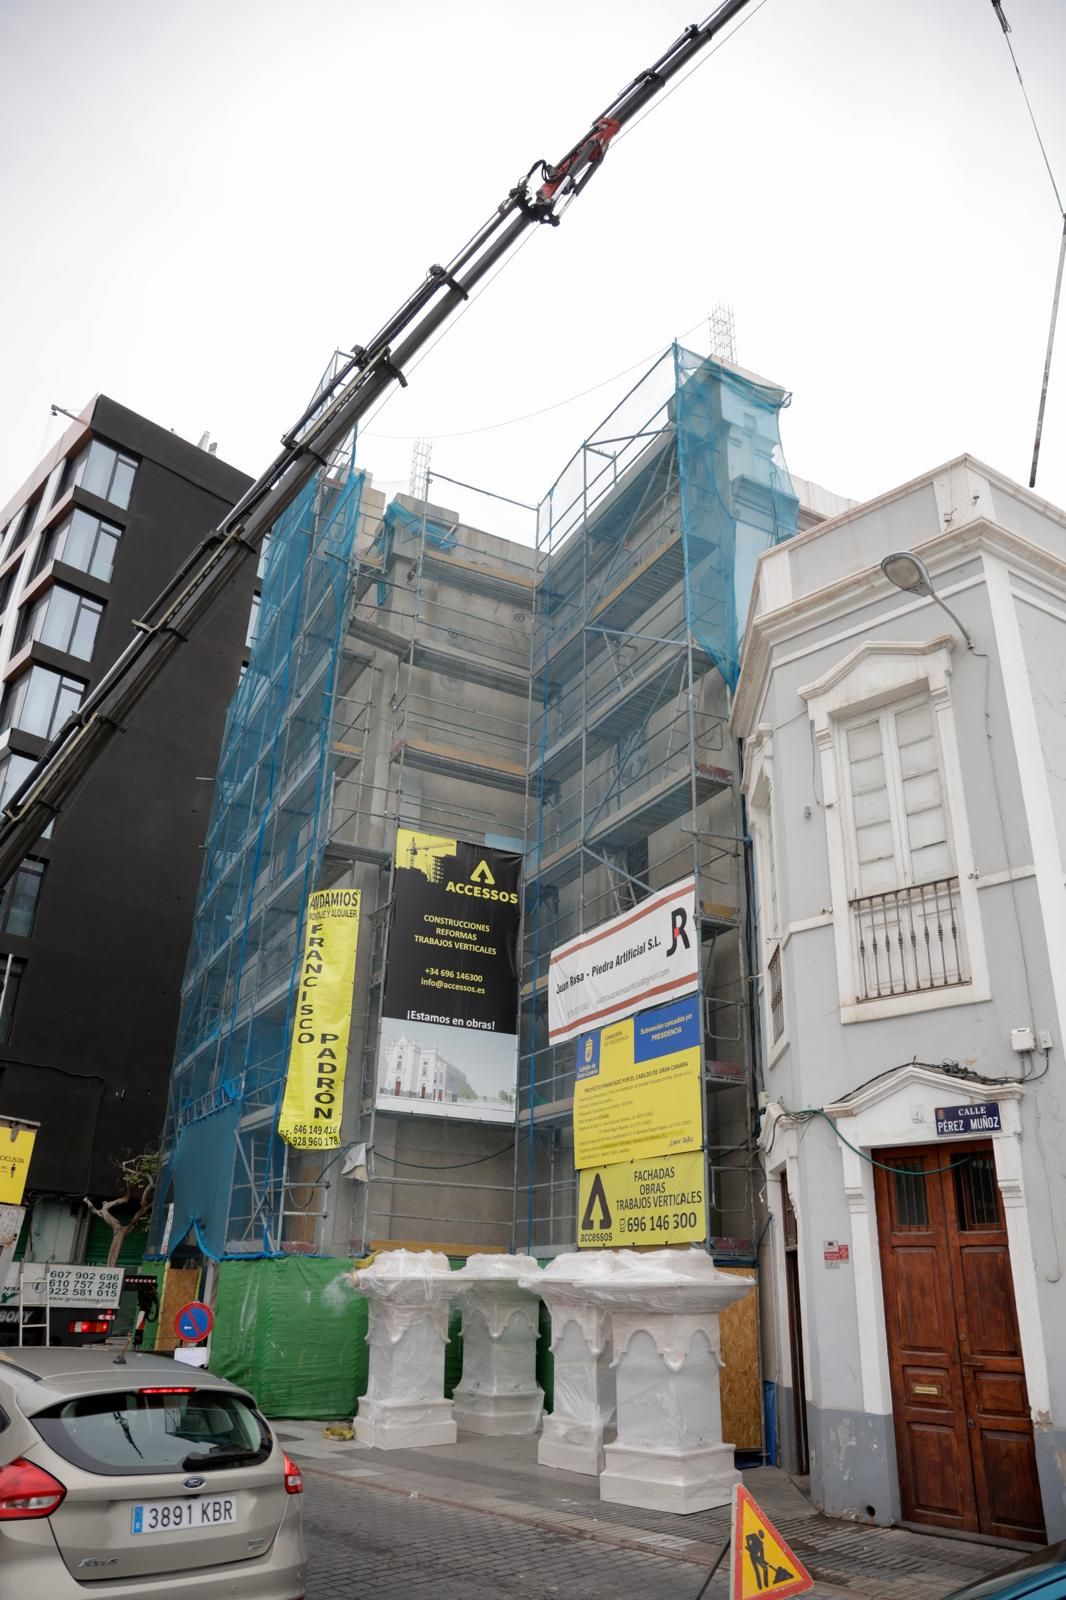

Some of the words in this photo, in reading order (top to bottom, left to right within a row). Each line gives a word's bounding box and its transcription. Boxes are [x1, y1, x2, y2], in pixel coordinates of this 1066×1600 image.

[445, 881, 519, 904] ACCESSOS
[310, 892, 358, 910] ANDAMIOS
[331, 909, 358, 918] ALQUILER
[423, 914, 490, 932] CONSTRUCCIONES
[436, 927, 477, 941] REFORMAS
[414, 934, 453, 948] TRABAJOS
[454, 941, 497, 955] VERTICALES
[591, 960, 614, 977] Piedra
[615, 942, 646, 968] Artificial
[647, 935, 662, 950] S.L.
[425, 967, 439, 976] +34
[440, 969, 455, 978] 696
[456, 971, 483, 983] 146300
[297, 923, 325, 1044] FRANCISCO
[421, 977, 486, 994] info@accessos.es
[407, 1010, 450, 1024] ¡Estamos
[452, 1018, 464, 1026] en
[466, 1019, 496, 1031] obras!
[651, 1026, 683, 1041] PRESIDENCIA
[658, 1066, 670, 1074] GRAN
[670, 1061, 688, 1071] CANARIA
[313, 1033, 340, 1119] PADRÓN
[958, 1106, 987, 1116] CALLE
[293, 1124, 307, 1135] 646
[309, 1125, 323, 1135] 149
[938, 1119, 965, 1132] PÉREZ
[970, 1115, 1000, 1130] MUÑOZ
[292, 1136, 307, 1147] 928
[308, 1136, 323, 1147] 960
[634, 1166, 675, 1182] FACHADAS
[639, 1182, 666, 1195] OBRAS
[616, 1197, 652, 1211] TRABAJOS
[652, 1190, 702, 1207] VERTICALES
[627, 1217, 646, 1232] 696
[649, 1214, 670, 1231] 146
[672, 1211, 697, 1229] 300
[580, 1232, 613, 1242] accessos
[50, 1270, 71, 1279] 607
[75, 1272, 96, 1280] 902
[99, 1273, 119, 1281] 696
[48, 1287, 69, 1296] 922
[72, 1288, 92, 1296] 581
[96, 1289, 117, 1297] 015
[49, 1279, 70, 1287] 610
[73, 1280, 94, 1288] 757
[97, 1282, 118, 1290] 246
[148, 1504, 193, 1528] 3891
[201, 1500, 233, 1523] KBR
